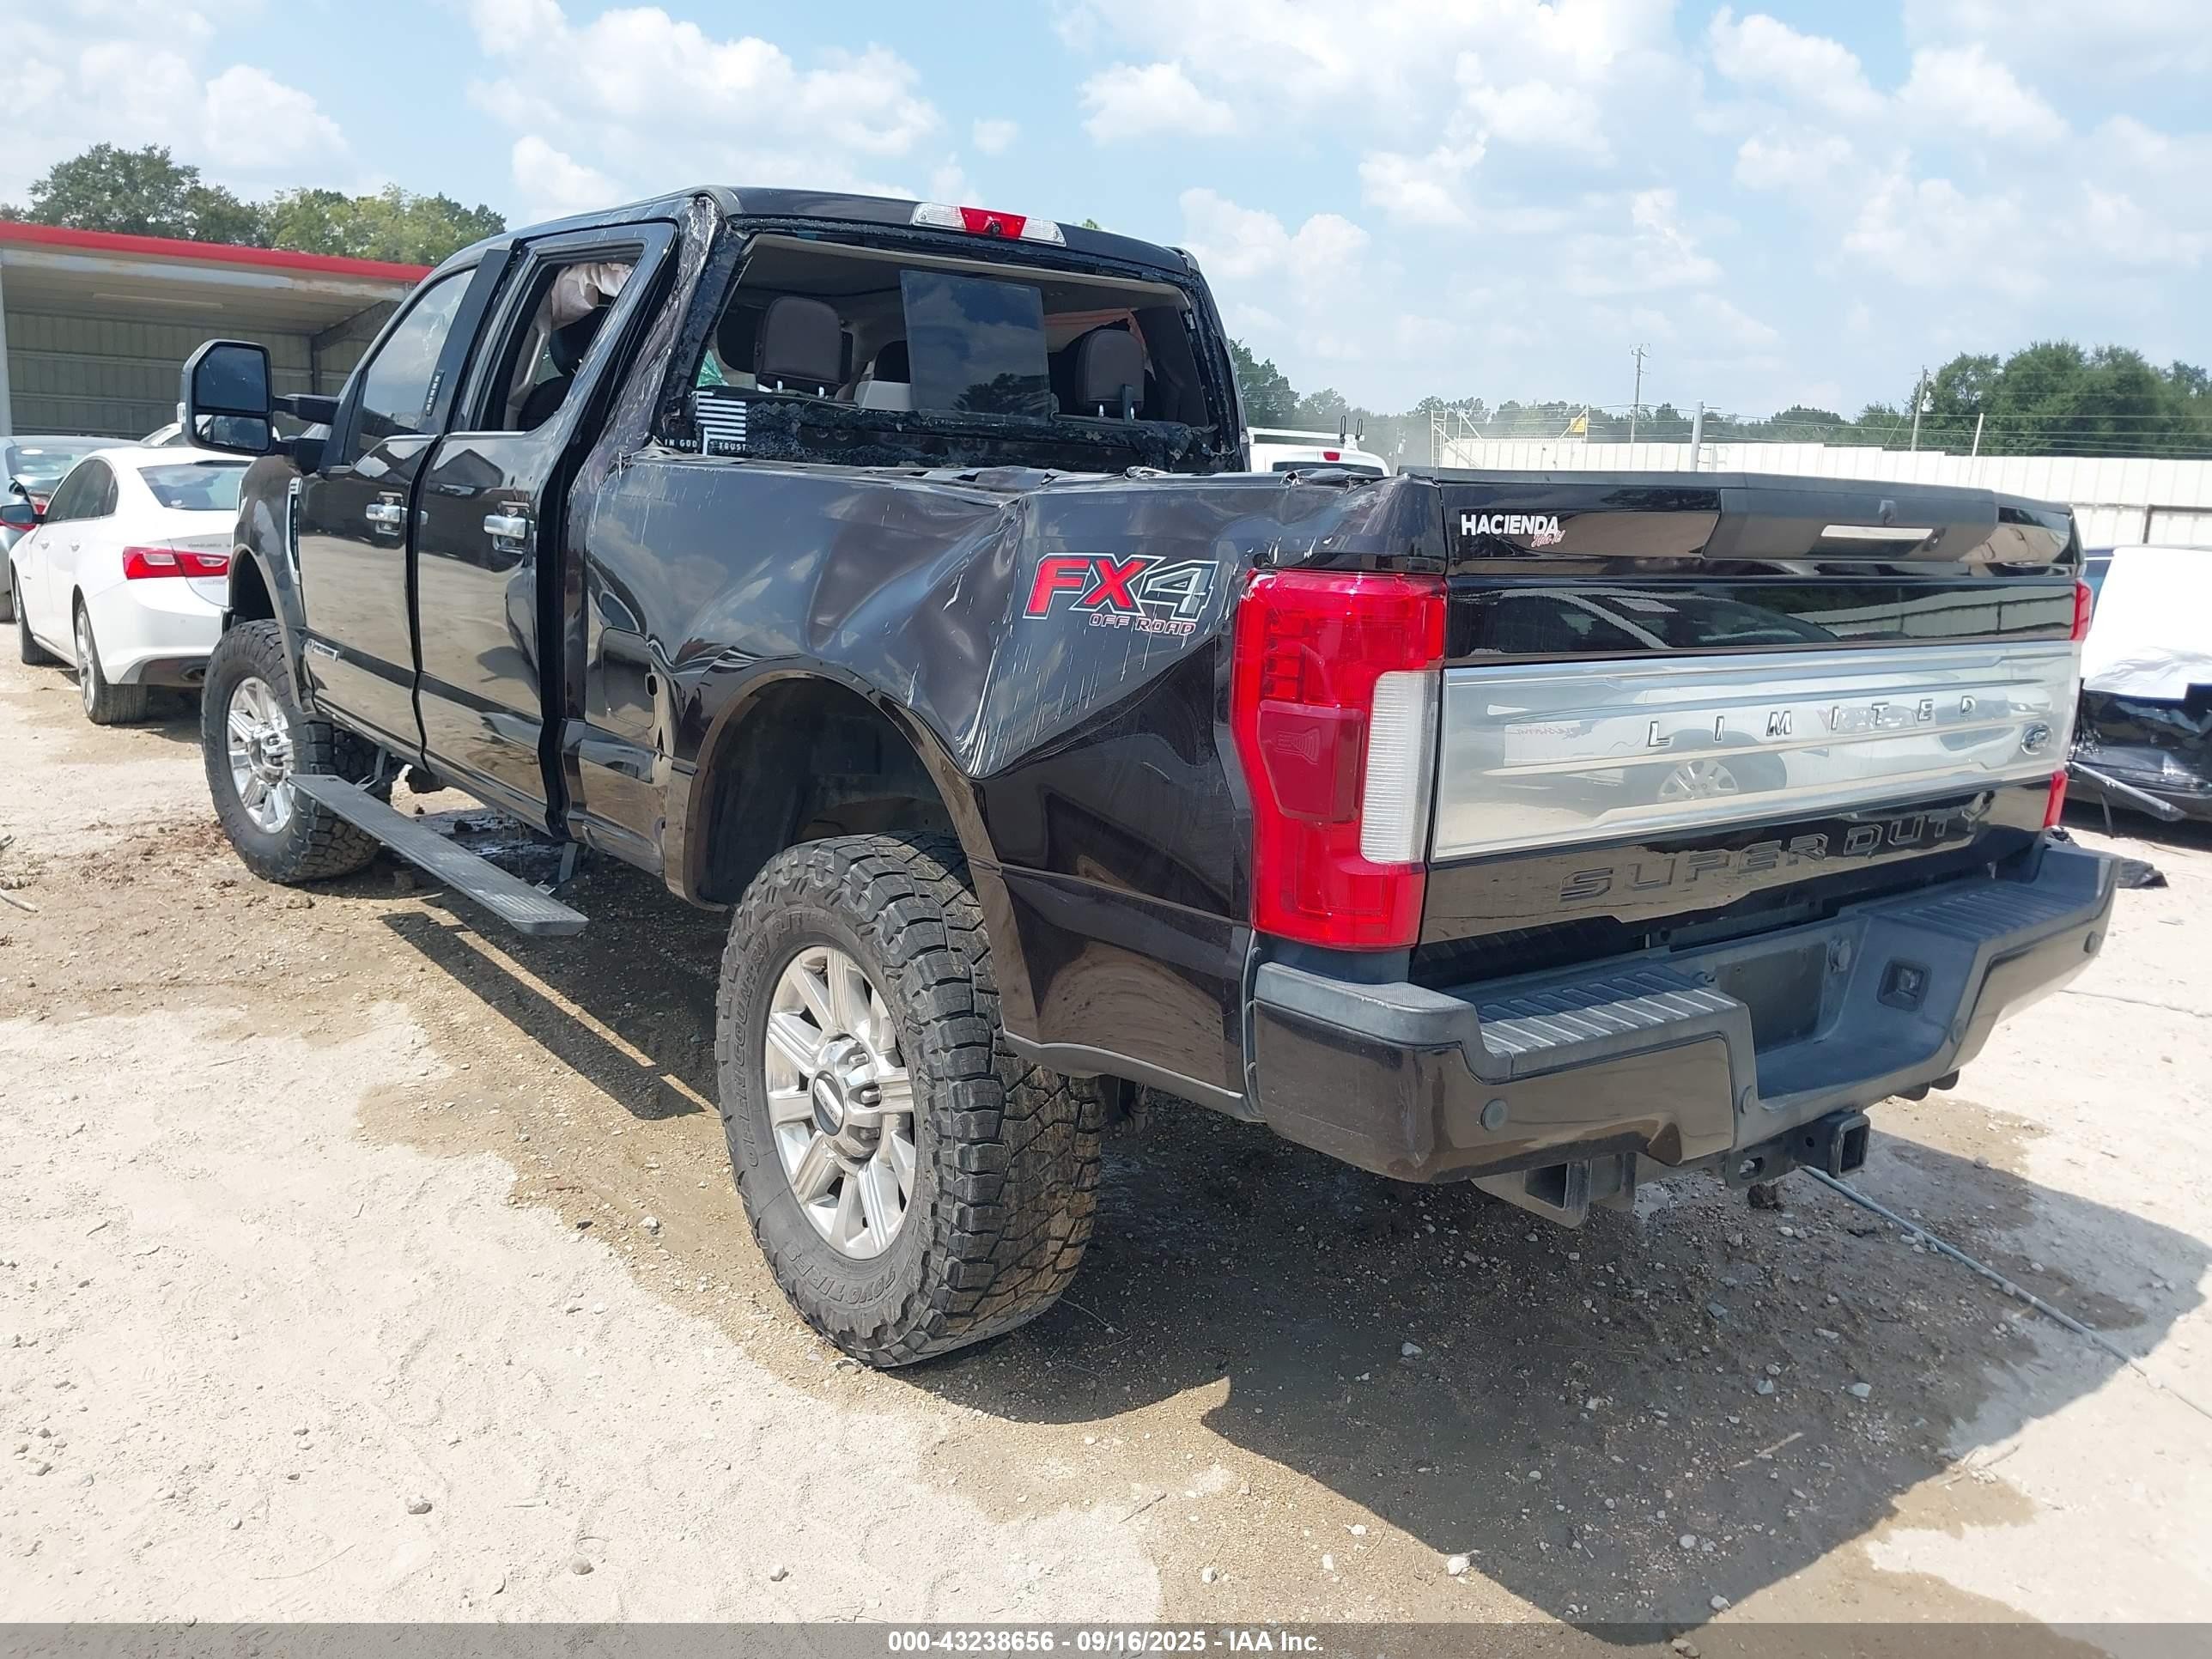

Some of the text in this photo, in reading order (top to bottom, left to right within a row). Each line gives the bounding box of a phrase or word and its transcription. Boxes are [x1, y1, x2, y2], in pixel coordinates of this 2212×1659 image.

[679, 439, 698, 447] GOD
[720, 442, 746, 451] TRUST
[1462, 514, 1559, 536] HACIENDA
[1023, 552, 1219, 622] FX4
[1089, 613, 1196, 636] OFF ROAD
[1647, 695, 1976, 748] LIMITED
[1559, 792, 1992, 902] SUPER DUTY
[734, 931, 770, 1066] COUNTRY
[734, 1076, 759, 1168] OPEN
